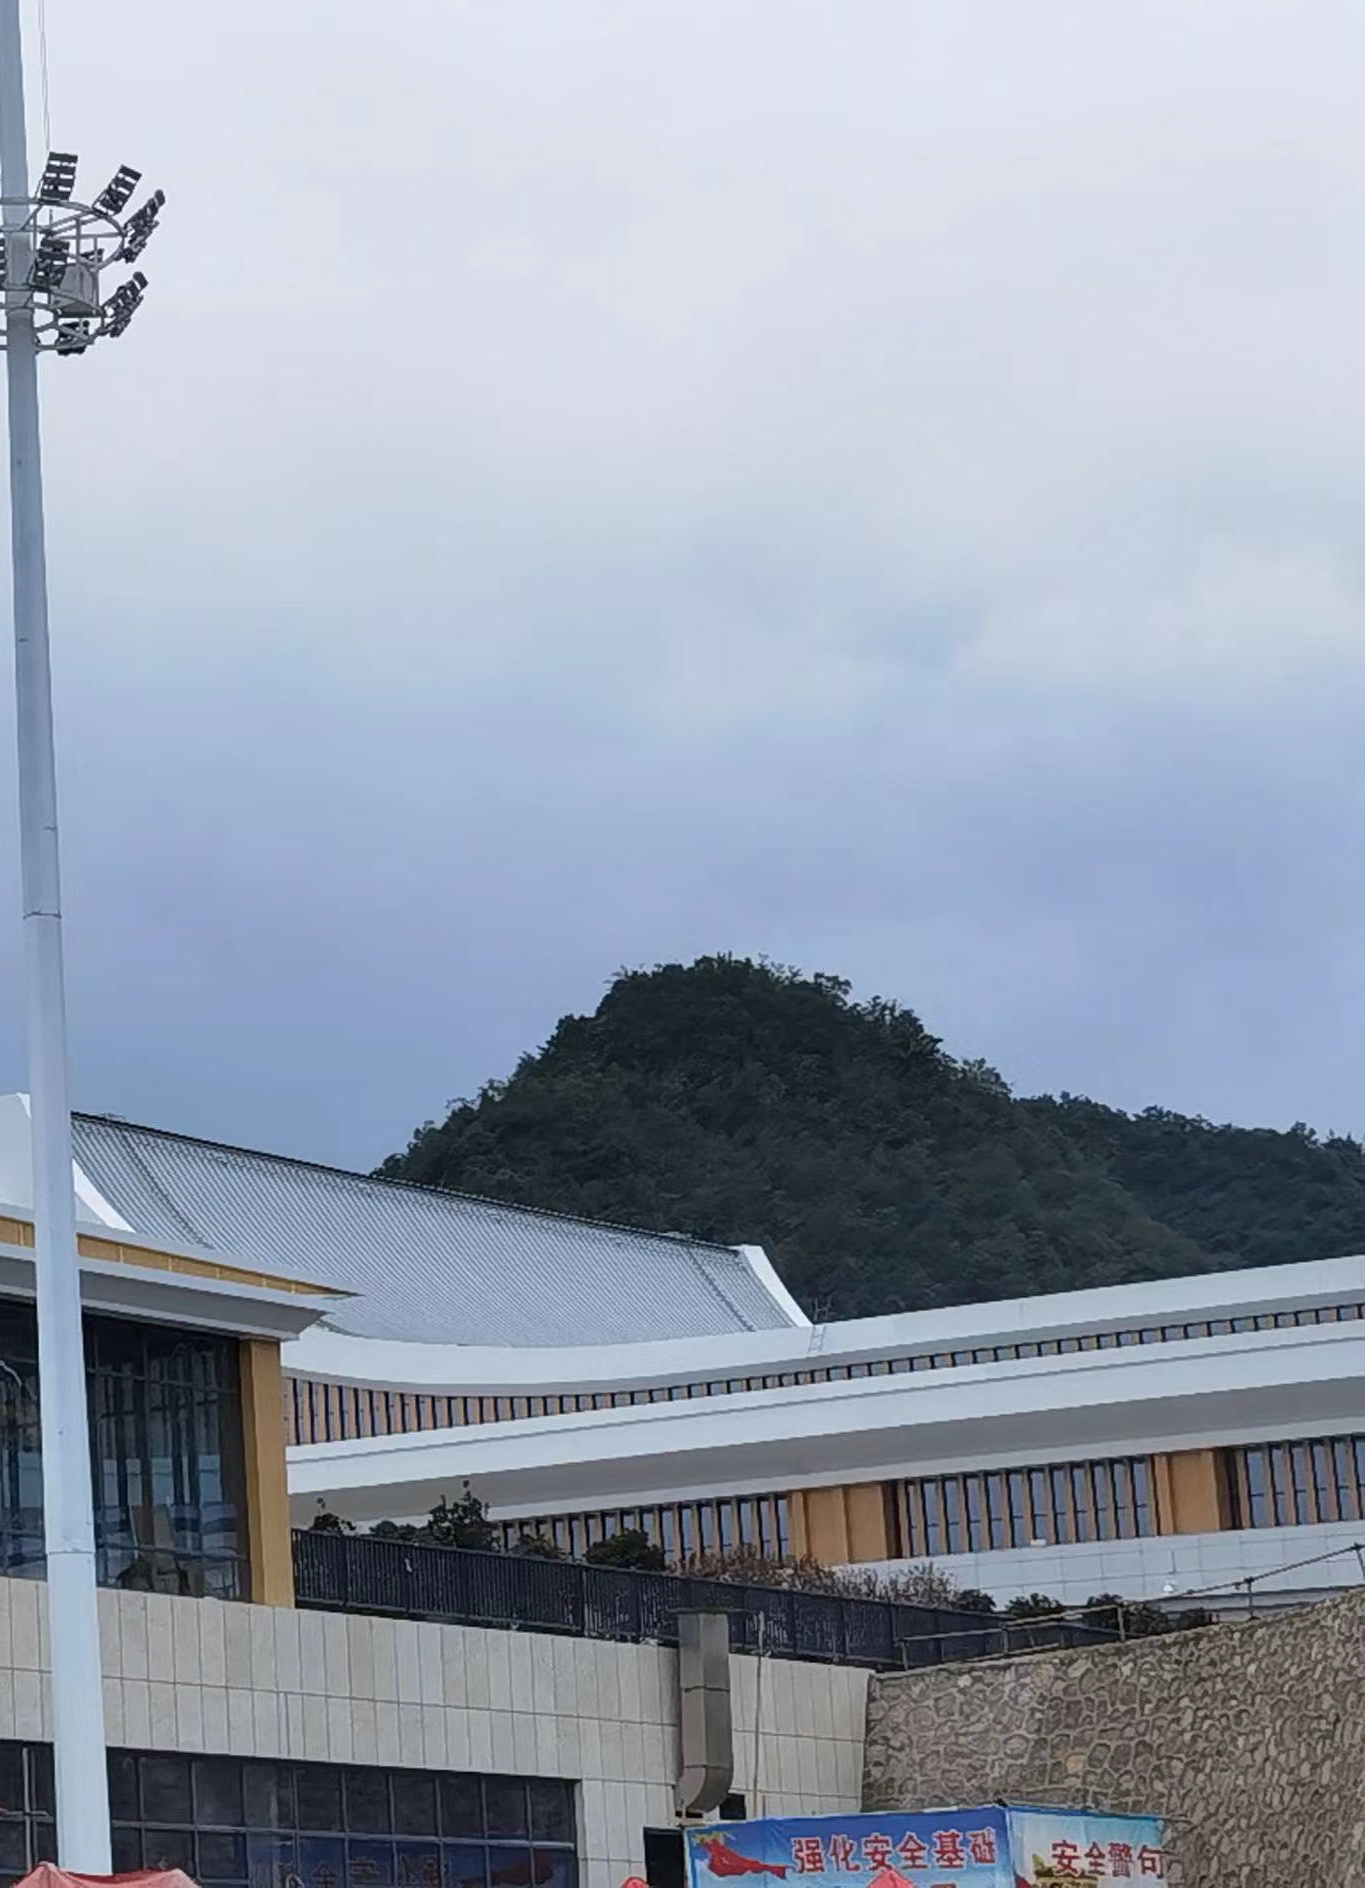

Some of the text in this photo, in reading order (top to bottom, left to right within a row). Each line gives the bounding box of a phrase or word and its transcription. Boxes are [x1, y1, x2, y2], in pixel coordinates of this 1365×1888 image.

[791, 1828, 997, 1874] 强化安全基础
[1050, 1839, 1165, 1879] 安全警句
